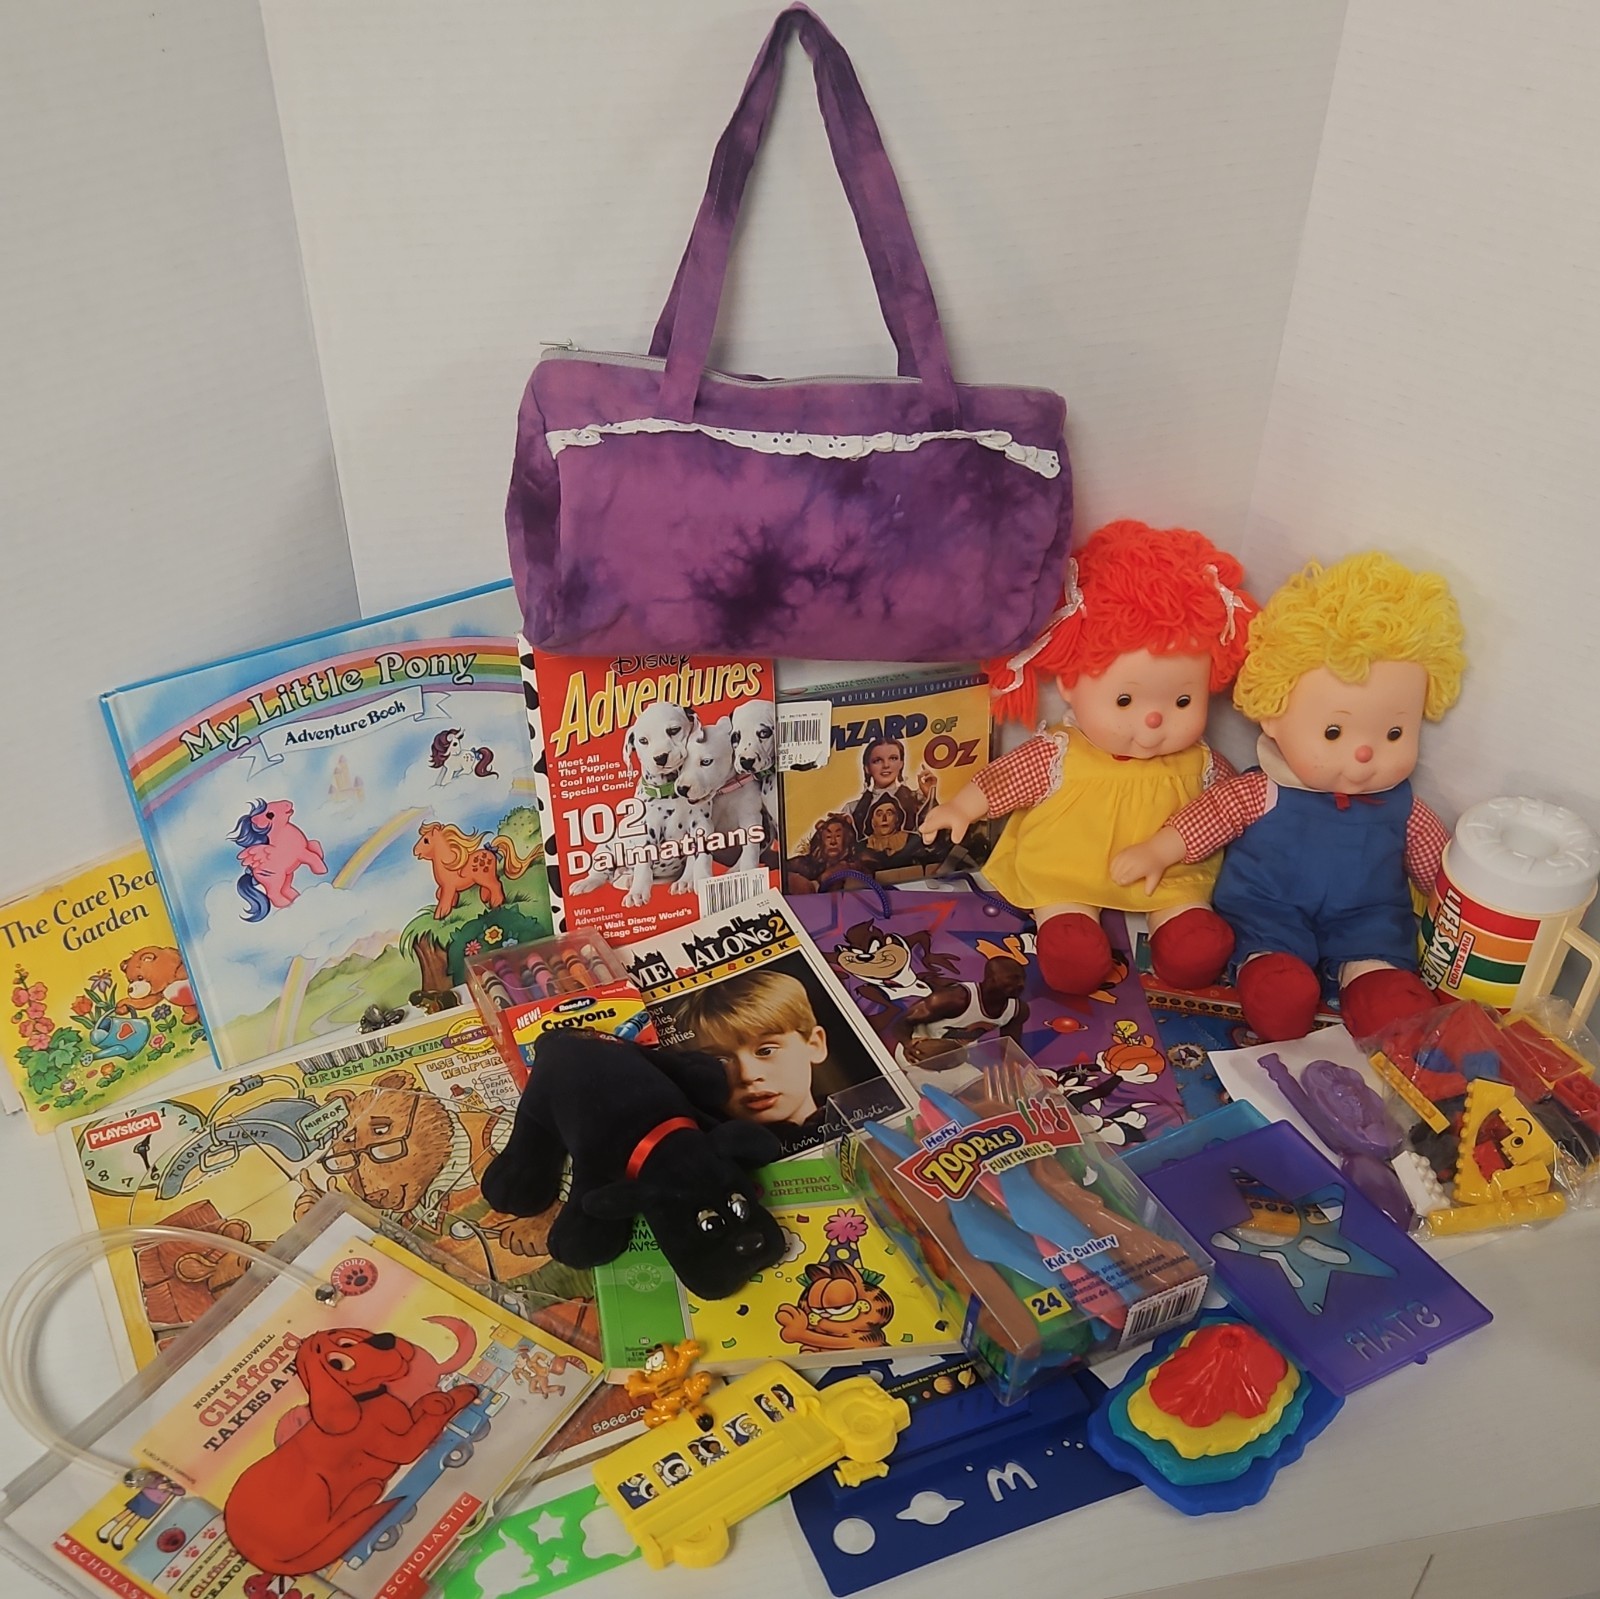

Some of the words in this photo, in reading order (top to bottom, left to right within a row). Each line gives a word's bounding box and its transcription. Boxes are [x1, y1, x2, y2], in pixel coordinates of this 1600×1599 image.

[842, 692, 875, 703] MOTION
[881, 685, 919, 697] PICTURE
[924, 677, 981, 690] SOUNDTRACK
[180, 715, 251, 762] My
[248, 667, 363, 725] Little
[374, 652, 477, 685] Pony
[550, 662, 762, 758] Adventures
[285, 717, 367, 746] Adventure
[366, 701, 406, 726] Book
[931, 716, 958, 734] OF
[558, 756, 584, 769] Meet
[586, 755, 600, 765] All
[558, 766, 579, 777] The
[580, 761, 621, 775] Puppies
[559, 777, 584, 788] Cool
[585, 772, 618, 785] Movie
[619, 769, 640, 782] Map
[560, 786, 599, 800] Special
[601, 780, 635, 793] Comic
[563, 799, 648, 847] 102
[566, 825, 766, 876] Dalmatians
[0, 918, 51, 948] The
[53, 890, 110, 925] Care
[108, 870, 158, 900] Bea
[574, 907, 592, 917] Win
[593, 905, 605, 914] an
[604, 919, 626, 931] Walt
[627, 915, 657, 928] Disney
[659, 908, 693, 921] World's
[62, 904, 149, 951] Garden
[603, 927, 632, 938] Stage
[633, 924, 658, 935] Show
[630, 962, 672, 989] ME
[768, 916, 790, 939] 2
[1460, 934, 1472, 955] FIVE
[1421, 926, 1455, 990] SAVER
[1449, 954, 1466, 985] FLAVOR
[650, 971, 714, 999] IVITY
[727, 942, 790, 971] BOOK
[558, 998, 590, 1012] RoseArt
[516, 1007, 541, 1030] NEW!
[541, 1007, 617, 1032] Crayons
[308, 1061, 365, 1086] BRUSH
[373, 1048, 414, 1068] MANY
[416, 1041, 445, 1055] TIM
[426, 1056, 455, 1072] USE
[486, 1078, 513, 1089] DENTAL
[490, 1087, 514, 1096] FLOSS
[178, 1114, 188, 1126] 2
[304, 1104, 345, 1131] MIRROR
[90, 1116, 159, 1144] PLAYSKOOL
[228, 1129, 269, 1140] LIGHT
[926, 1125, 959, 1148] Hefty
[780, 1136, 820, 1155] Kevin
[989, 1143, 1054, 1172] FUNTENSILS
[84, 1159, 95, 1171] 9
[98, 1170, 110, 1182] 8
[121, 1176, 134, 1188] 7
[769, 1183, 840, 1197] GREETINGS
[773, 1175, 832, 1187] BIRTHDAY
[1045, 1251, 1075, 1270] Kid's
[1073, 1235, 1117, 1258] Cutlery
[1031, 1292, 1063, 1316] 24
[193, 1371, 233, 1409] NORMAN
[231, 1332, 276, 1374] BRIDWELL
[198, 1330, 301, 1427] Clifford
[203, 1388, 272, 1452] TAKES
[272, 1378, 289, 1394] A
[386, 1496, 472, 1596] SCHOLASTIC
[68, 1544, 150, 1599] SCHOLAS
